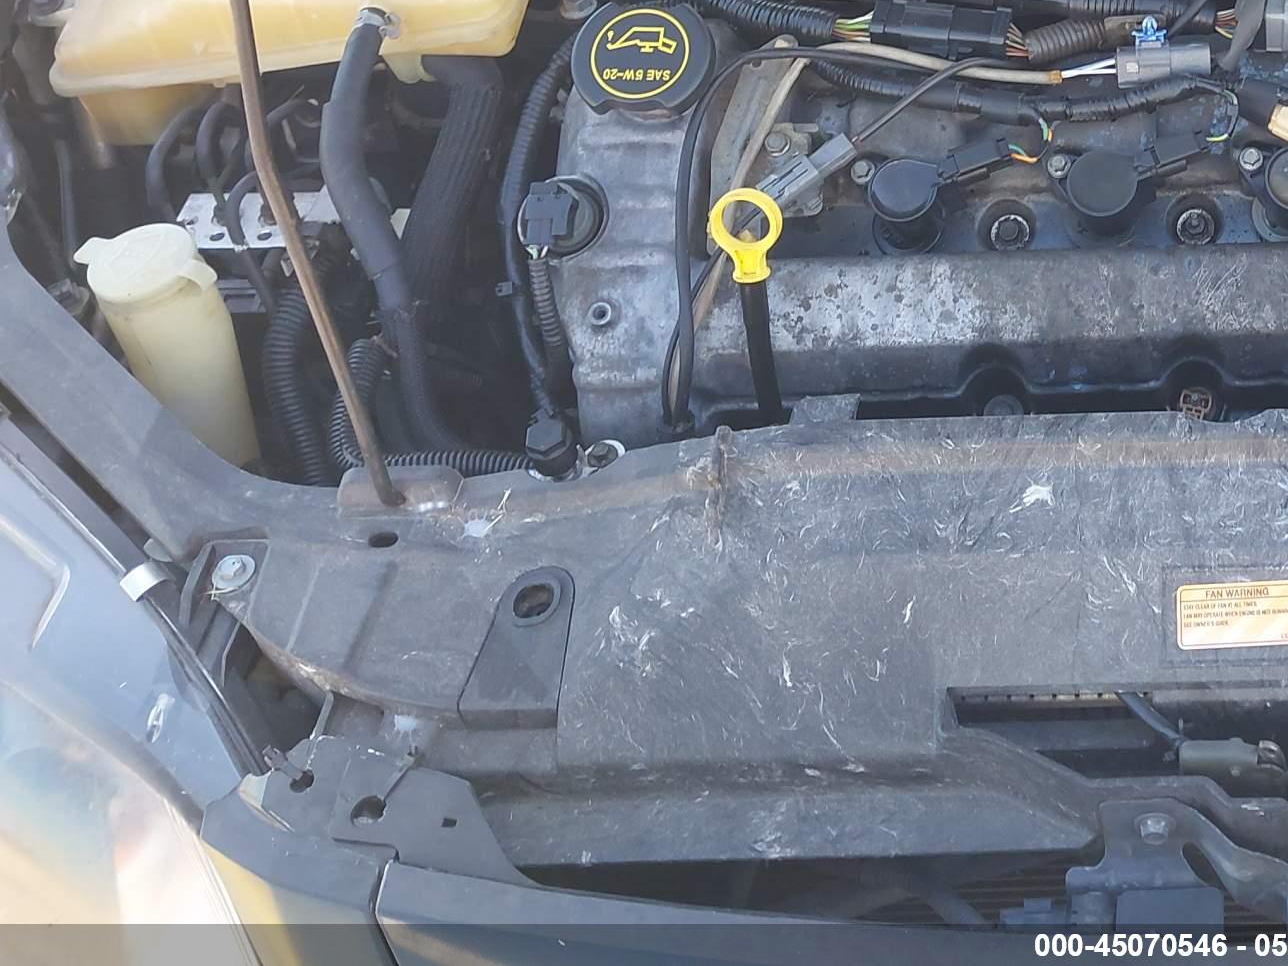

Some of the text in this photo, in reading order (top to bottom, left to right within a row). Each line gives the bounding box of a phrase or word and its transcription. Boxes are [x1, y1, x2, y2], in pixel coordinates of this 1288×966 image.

[603, 68, 671, 81] SAE 5W-20
[1205, 587, 1270, 599] FAN WARNING
